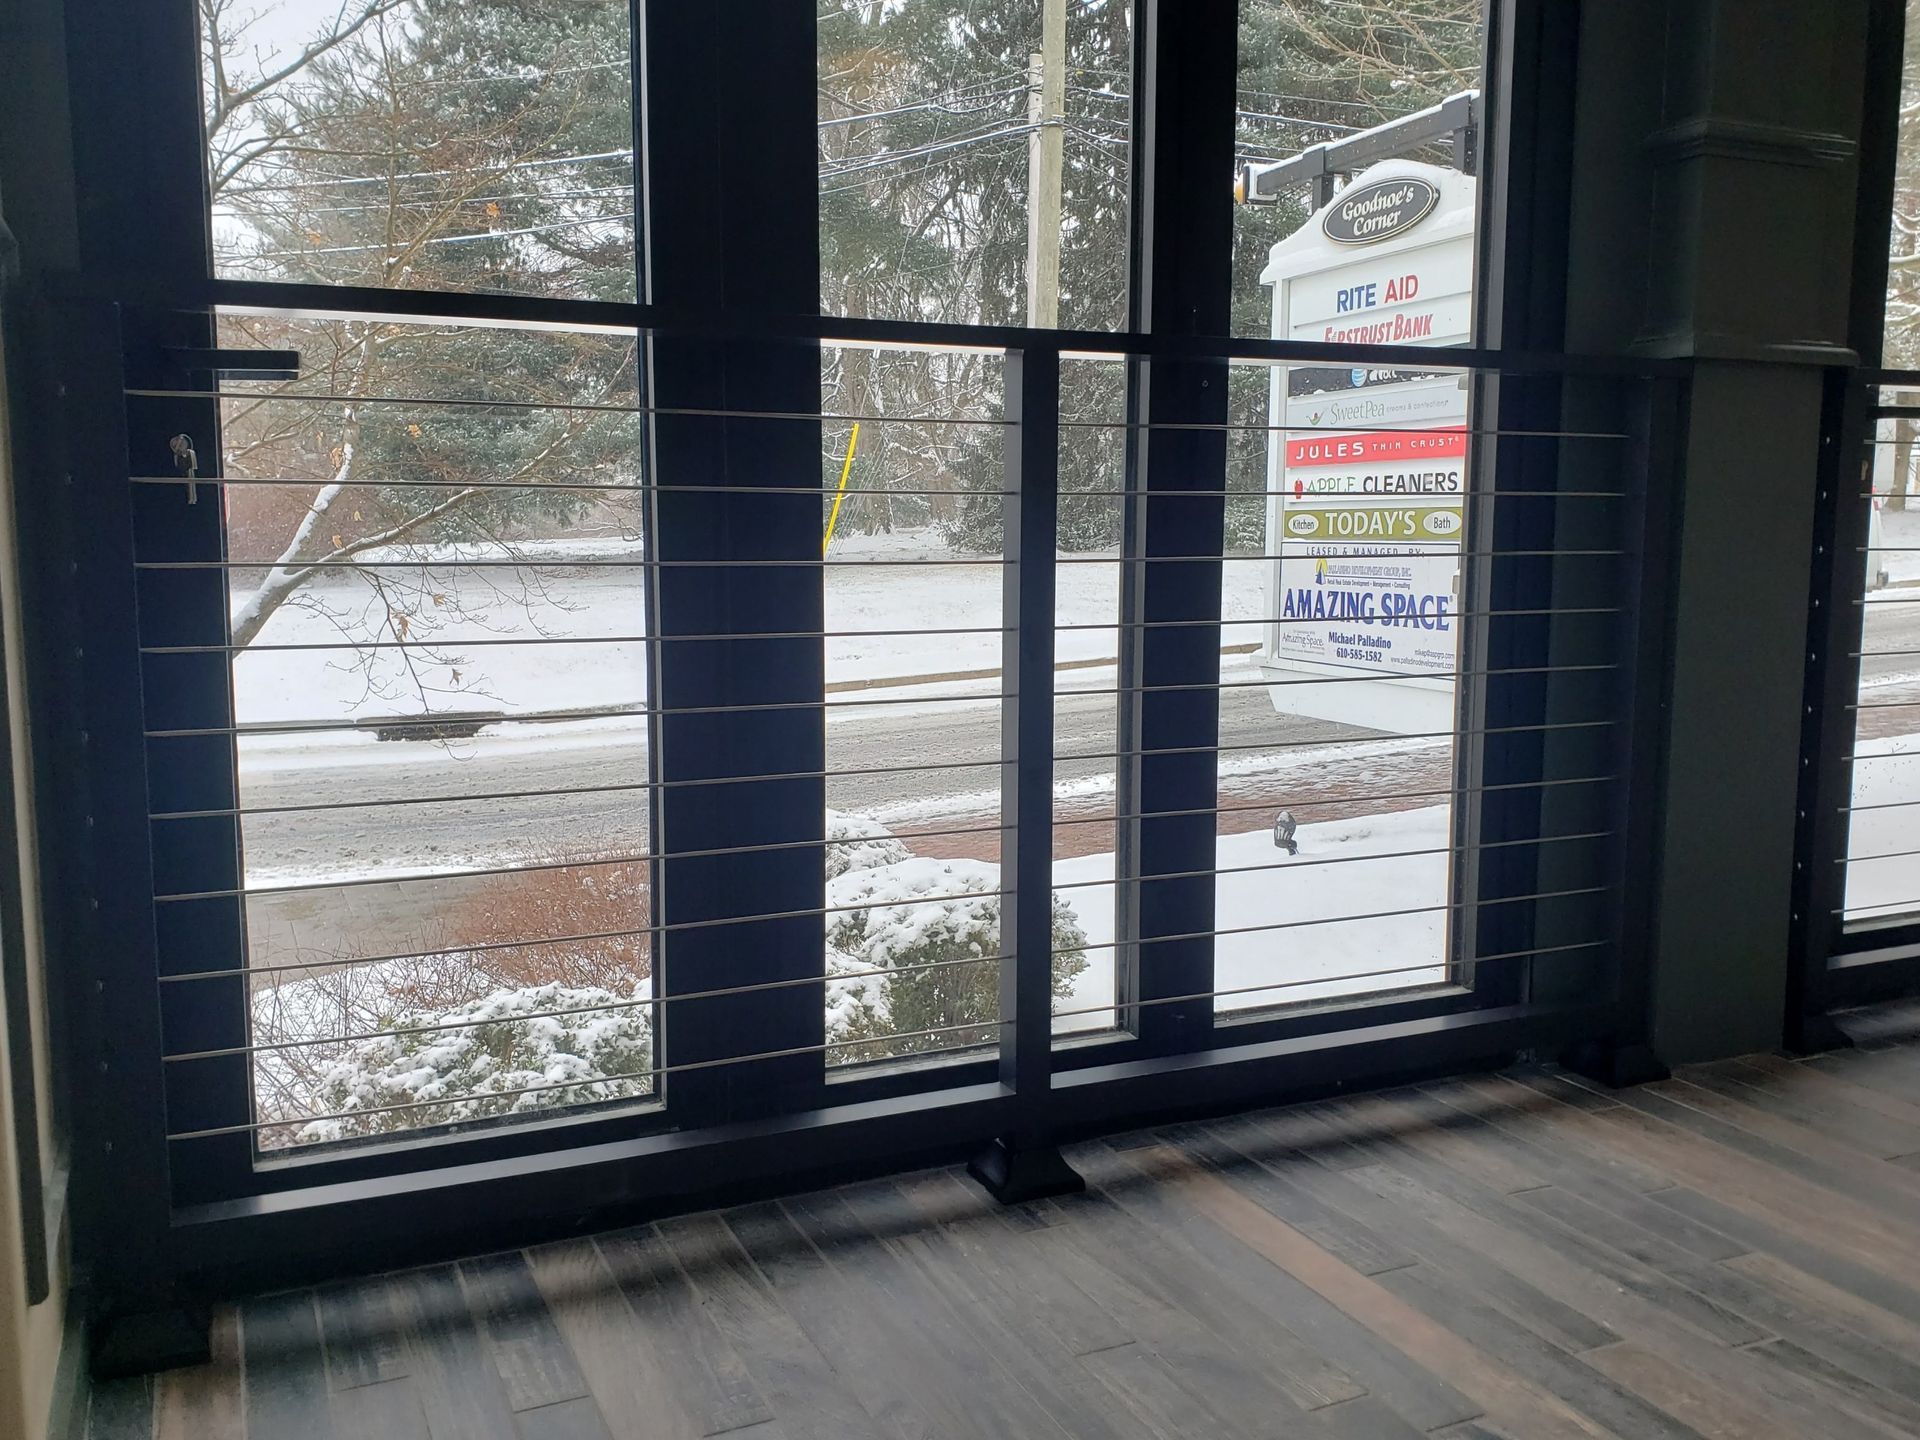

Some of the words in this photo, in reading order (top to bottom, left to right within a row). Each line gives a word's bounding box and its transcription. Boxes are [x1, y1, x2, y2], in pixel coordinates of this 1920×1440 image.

[1342, 185, 1414, 222] Goodnoe's
[1353, 209, 1401, 236] Corner
[1337, 283, 1376, 313] RITE
[1384, 274, 1419, 304] AID
[1296, 442, 1365, 460] JULES
[1373, 442, 1400, 451] THIN
[1307, 476, 1356, 498] APPLE
[1363, 472, 1458, 493] CLEANERS
[1292, 519, 1315, 530] Kitchen
[1325, 510, 1416, 535] TODAY'S
[1433, 517, 1451, 529] Bath
[1306, 546, 1338, 556] LEASED
[1352, 547, 1398, 556] MANAGED
[1283, 588, 1375, 625] AMAZING
[1381, 593, 1450, 631] SPACE
[1328, 632, 1356, 646] Michael
[1357, 634, 1392, 649] Palladino
[1336, 647, 1383, 663] 610-585-1582
